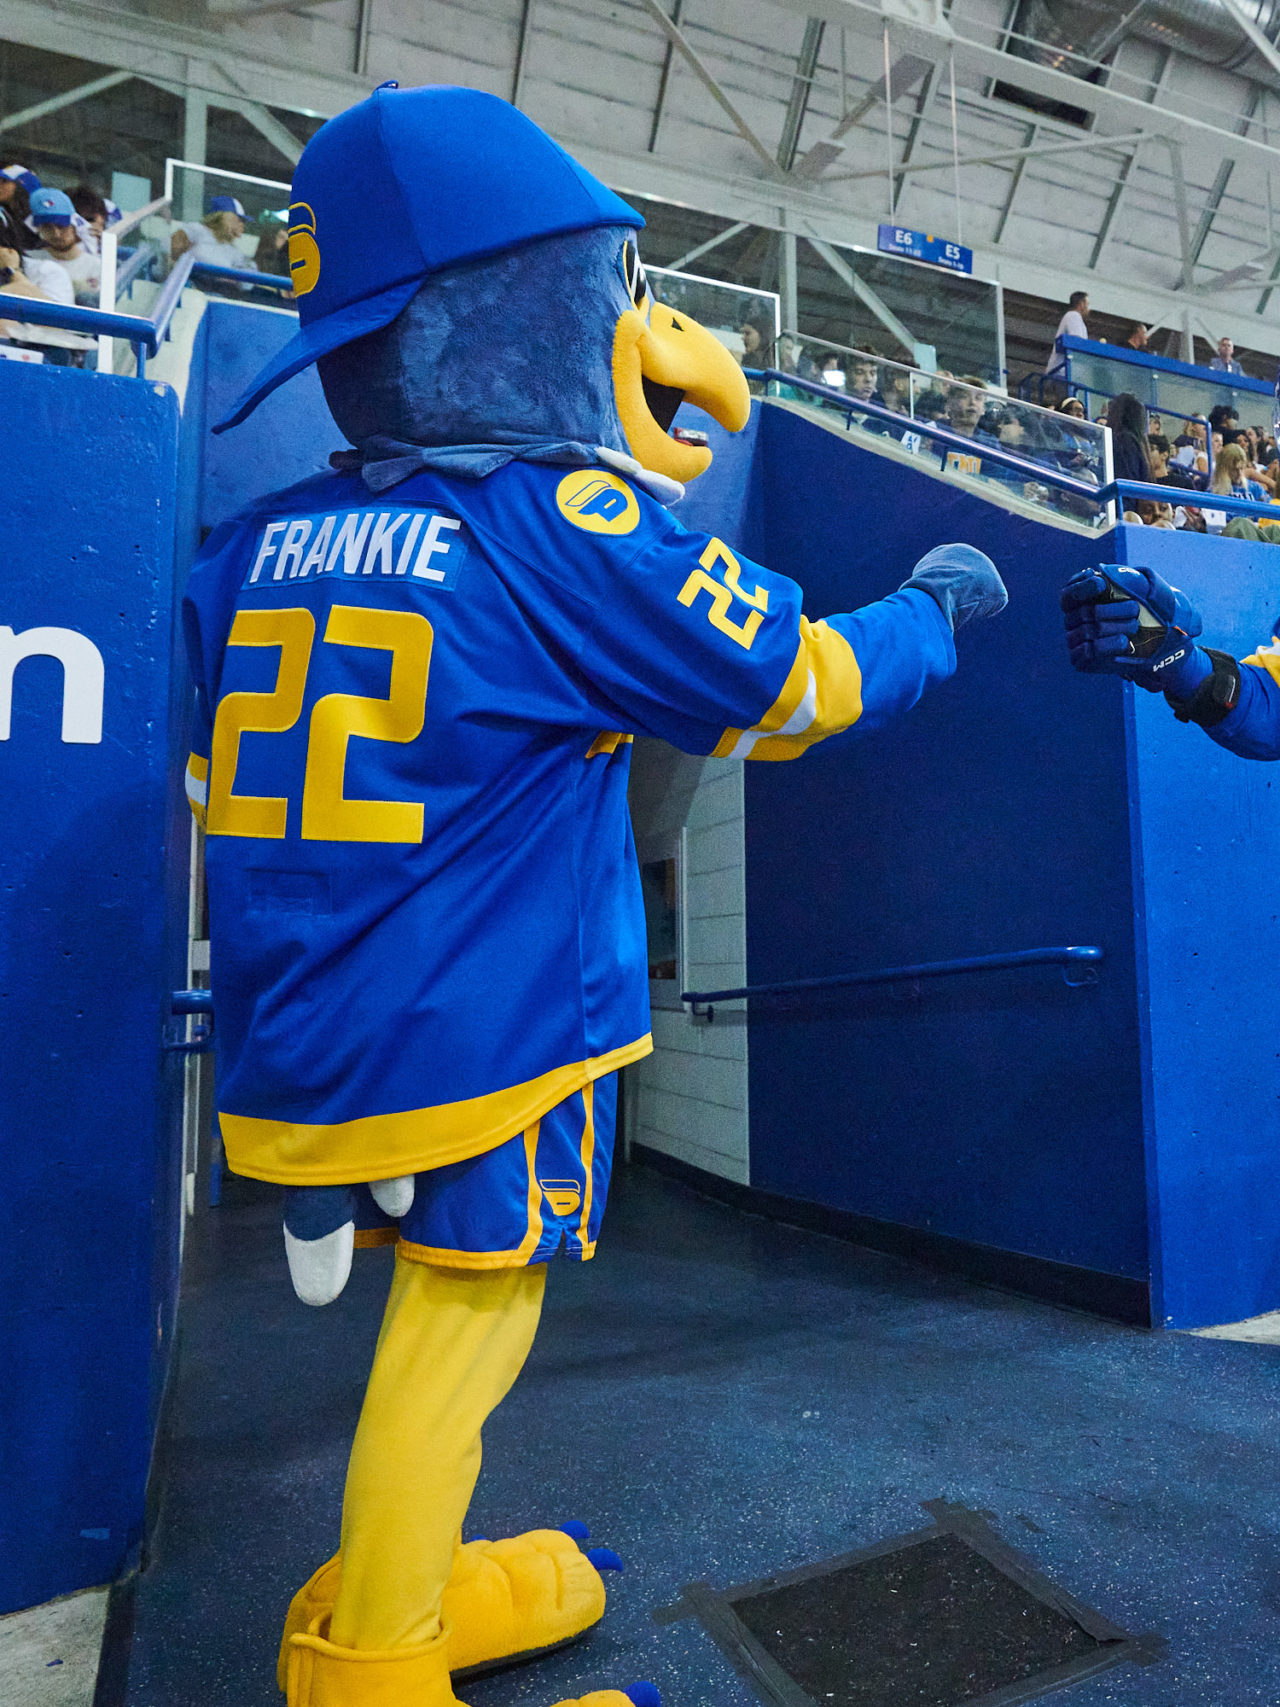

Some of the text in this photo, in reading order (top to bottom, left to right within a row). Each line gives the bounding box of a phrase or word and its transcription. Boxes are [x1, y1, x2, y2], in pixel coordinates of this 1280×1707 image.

[895, 229, 913, 246] E6
[945, 244, 960, 260] E5
[249, 512, 462, 583] FRANKIE
[676, 536, 770, 651] 22
[1153, 648, 1186, 673] CCM
[206, 603, 435, 844] 22
